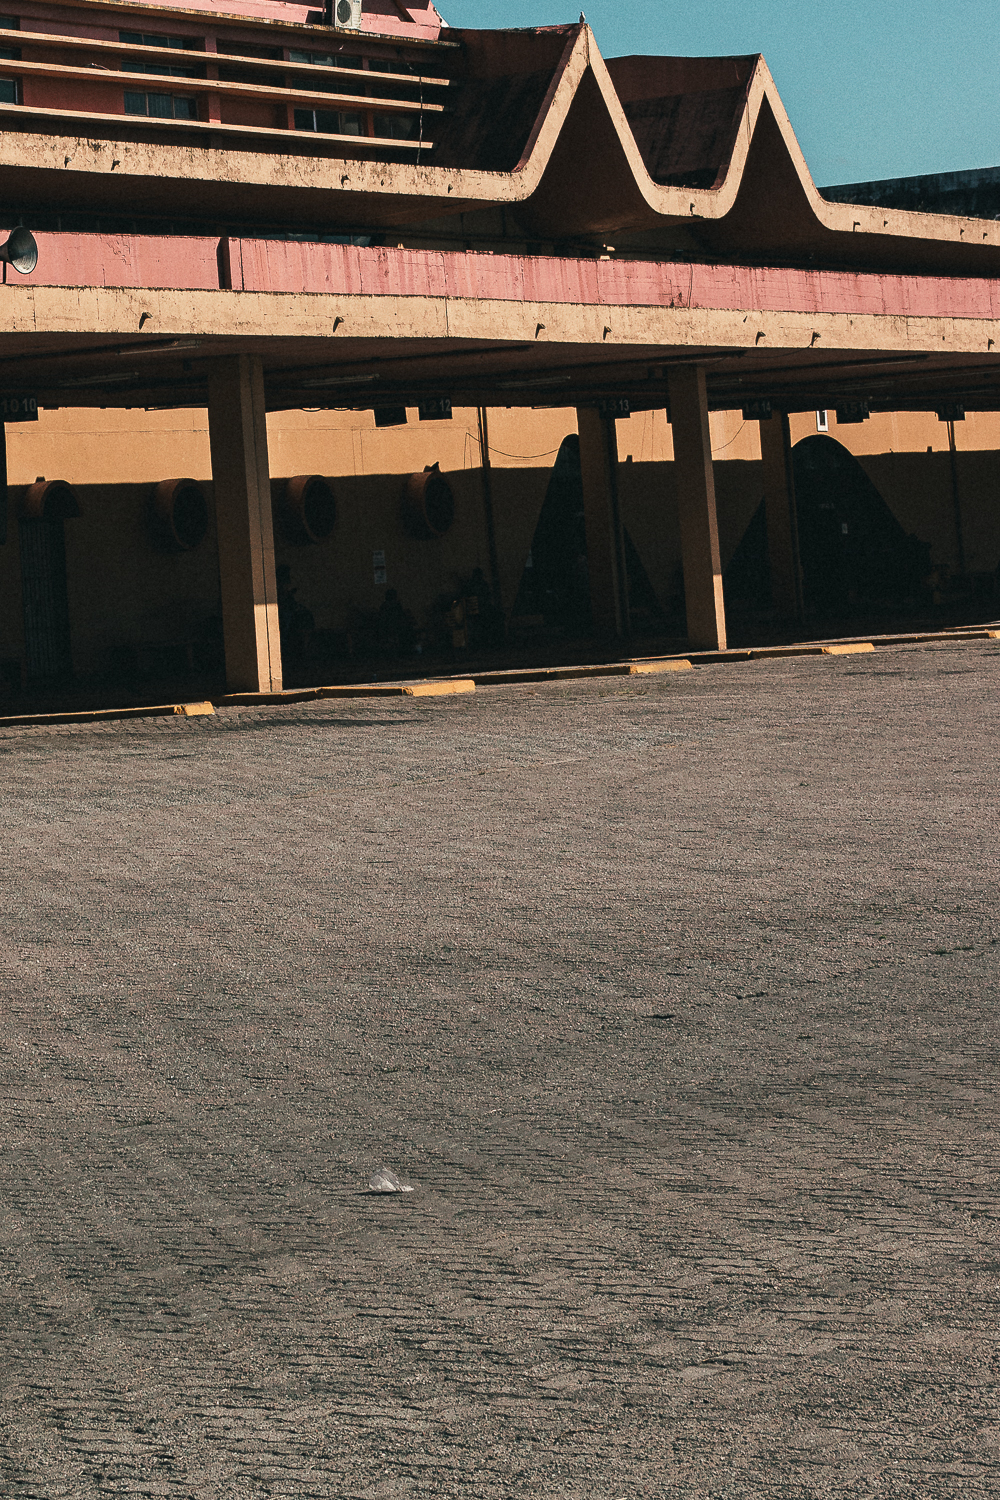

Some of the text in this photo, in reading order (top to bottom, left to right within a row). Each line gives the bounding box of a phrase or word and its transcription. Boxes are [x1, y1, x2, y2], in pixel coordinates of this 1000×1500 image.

[22, 398, 37, 412] 10
[439, 398, 451, 412] 12
[619, 399, 630, 411] 13
